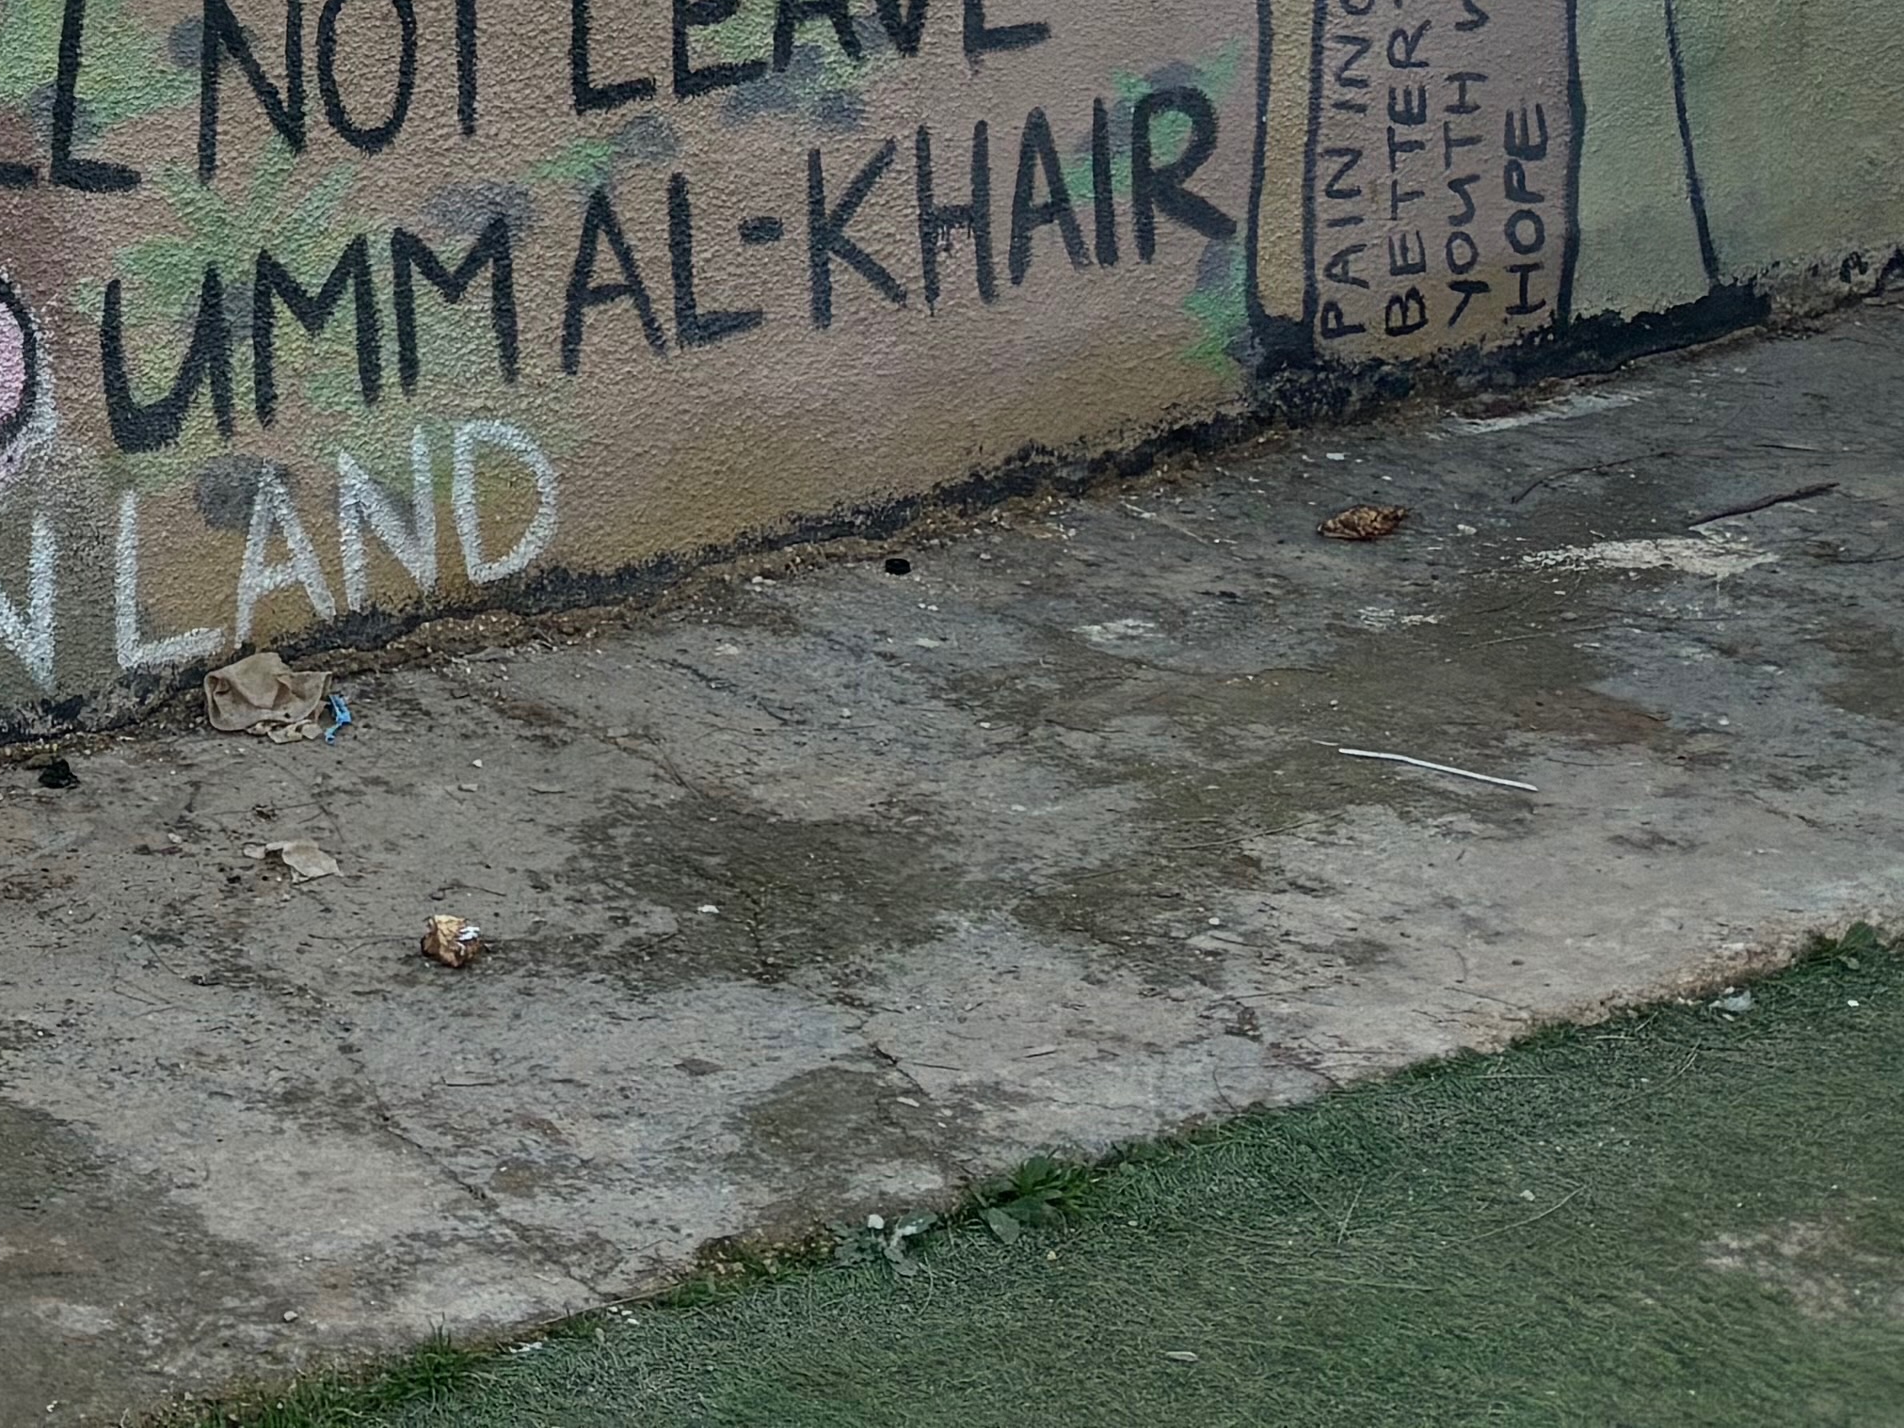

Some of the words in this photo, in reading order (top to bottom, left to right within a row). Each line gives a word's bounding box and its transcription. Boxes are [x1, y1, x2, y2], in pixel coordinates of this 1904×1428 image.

[1322, 144, 1370, 341] PAIN
[1384, 17, 1430, 338] BETTER
[1445, 70, 1490, 330] YOUTH
[1503, 97, 1548, 318] HOPE
[114, 417, 562, 672] LAND
